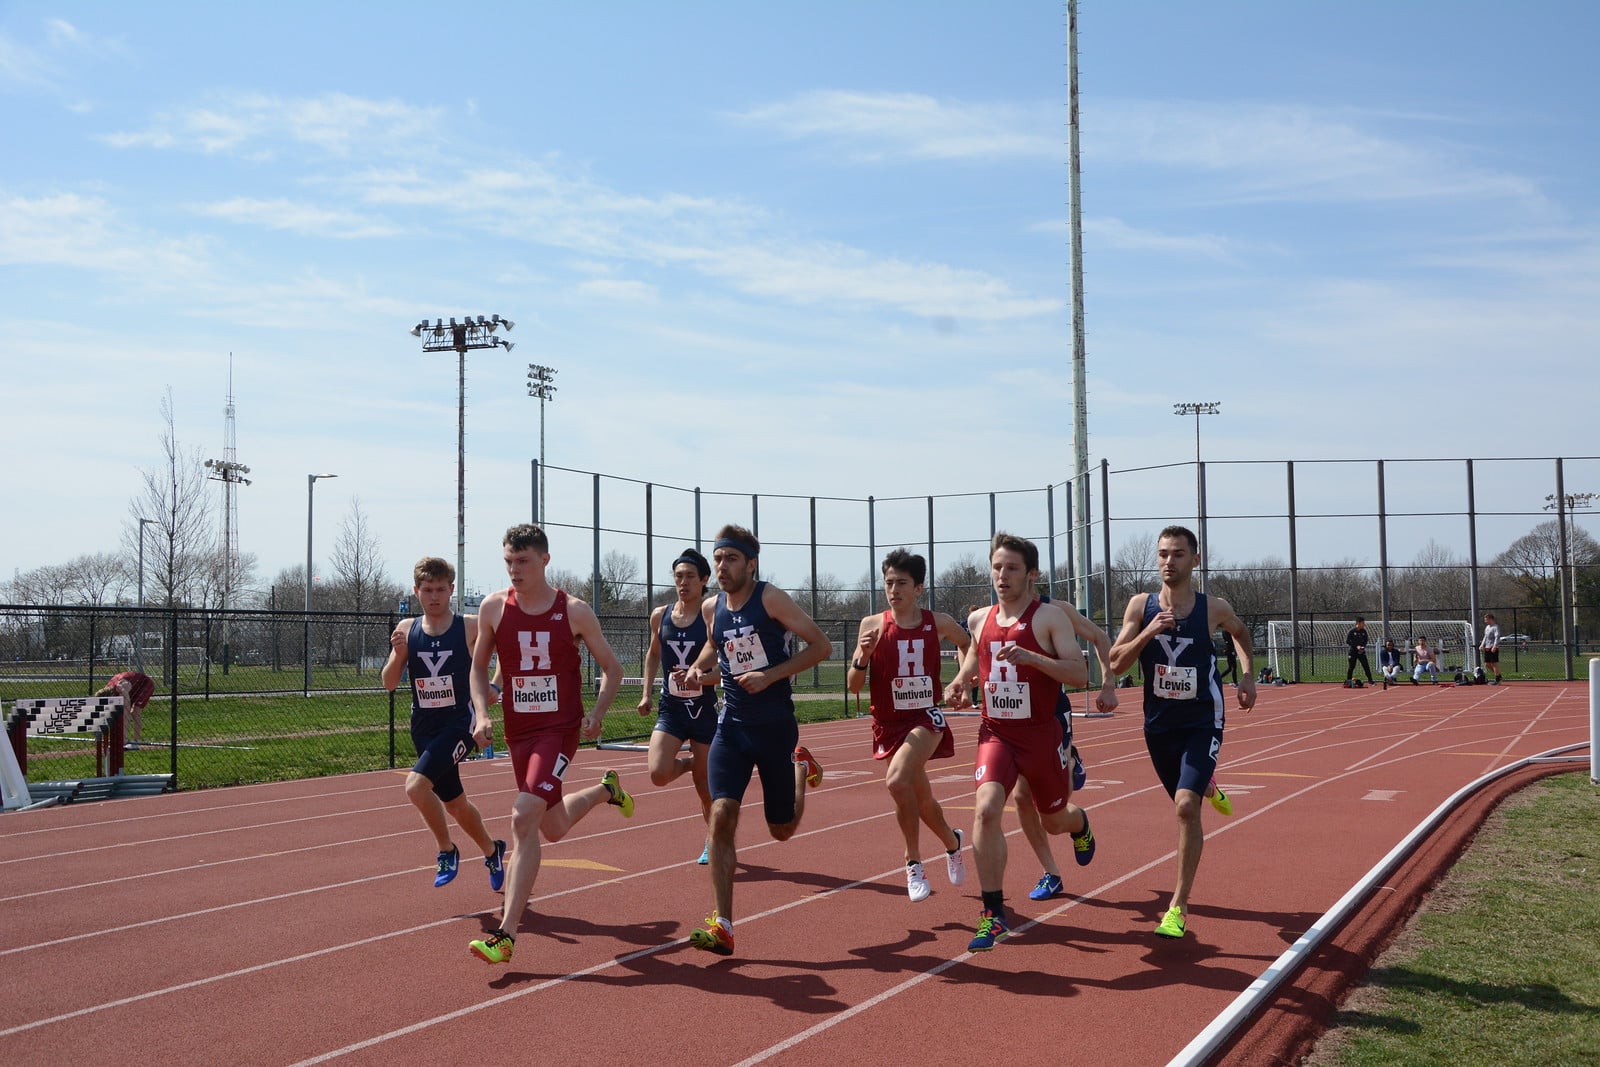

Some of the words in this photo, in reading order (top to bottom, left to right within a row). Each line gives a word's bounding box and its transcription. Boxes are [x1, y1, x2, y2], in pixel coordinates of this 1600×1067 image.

[517, 631, 551, 670] H
[666, 640, 696, 669] Y
[1154, 633, 1194, 667] Y
[417, 650, 453, 677] Y
[736, 651, 754, 664] Cox
[897, 639, 925, 677] H
[988, 640, 1018, 682] H
[1184, 668, 1193, 678] Y
[440, 677, 448, 685] Y
[544, 678, 552, 687] Y
[920, 678, 928, 686] Y
[1159, 680, 1191, 691] Lewis
[418, 689, 453, 700] Noonan
[893, 689, 933, 700] Tuntivate
[1016, 684, 1025, 693] Y
[514, 690, 557, 702] Hackett
[991, 696, 1022, 709] Kolor
[931, 709, 944, 725] 5
[37, 726, 64, 734] UCS
[557, 755, 569, 777] 7
